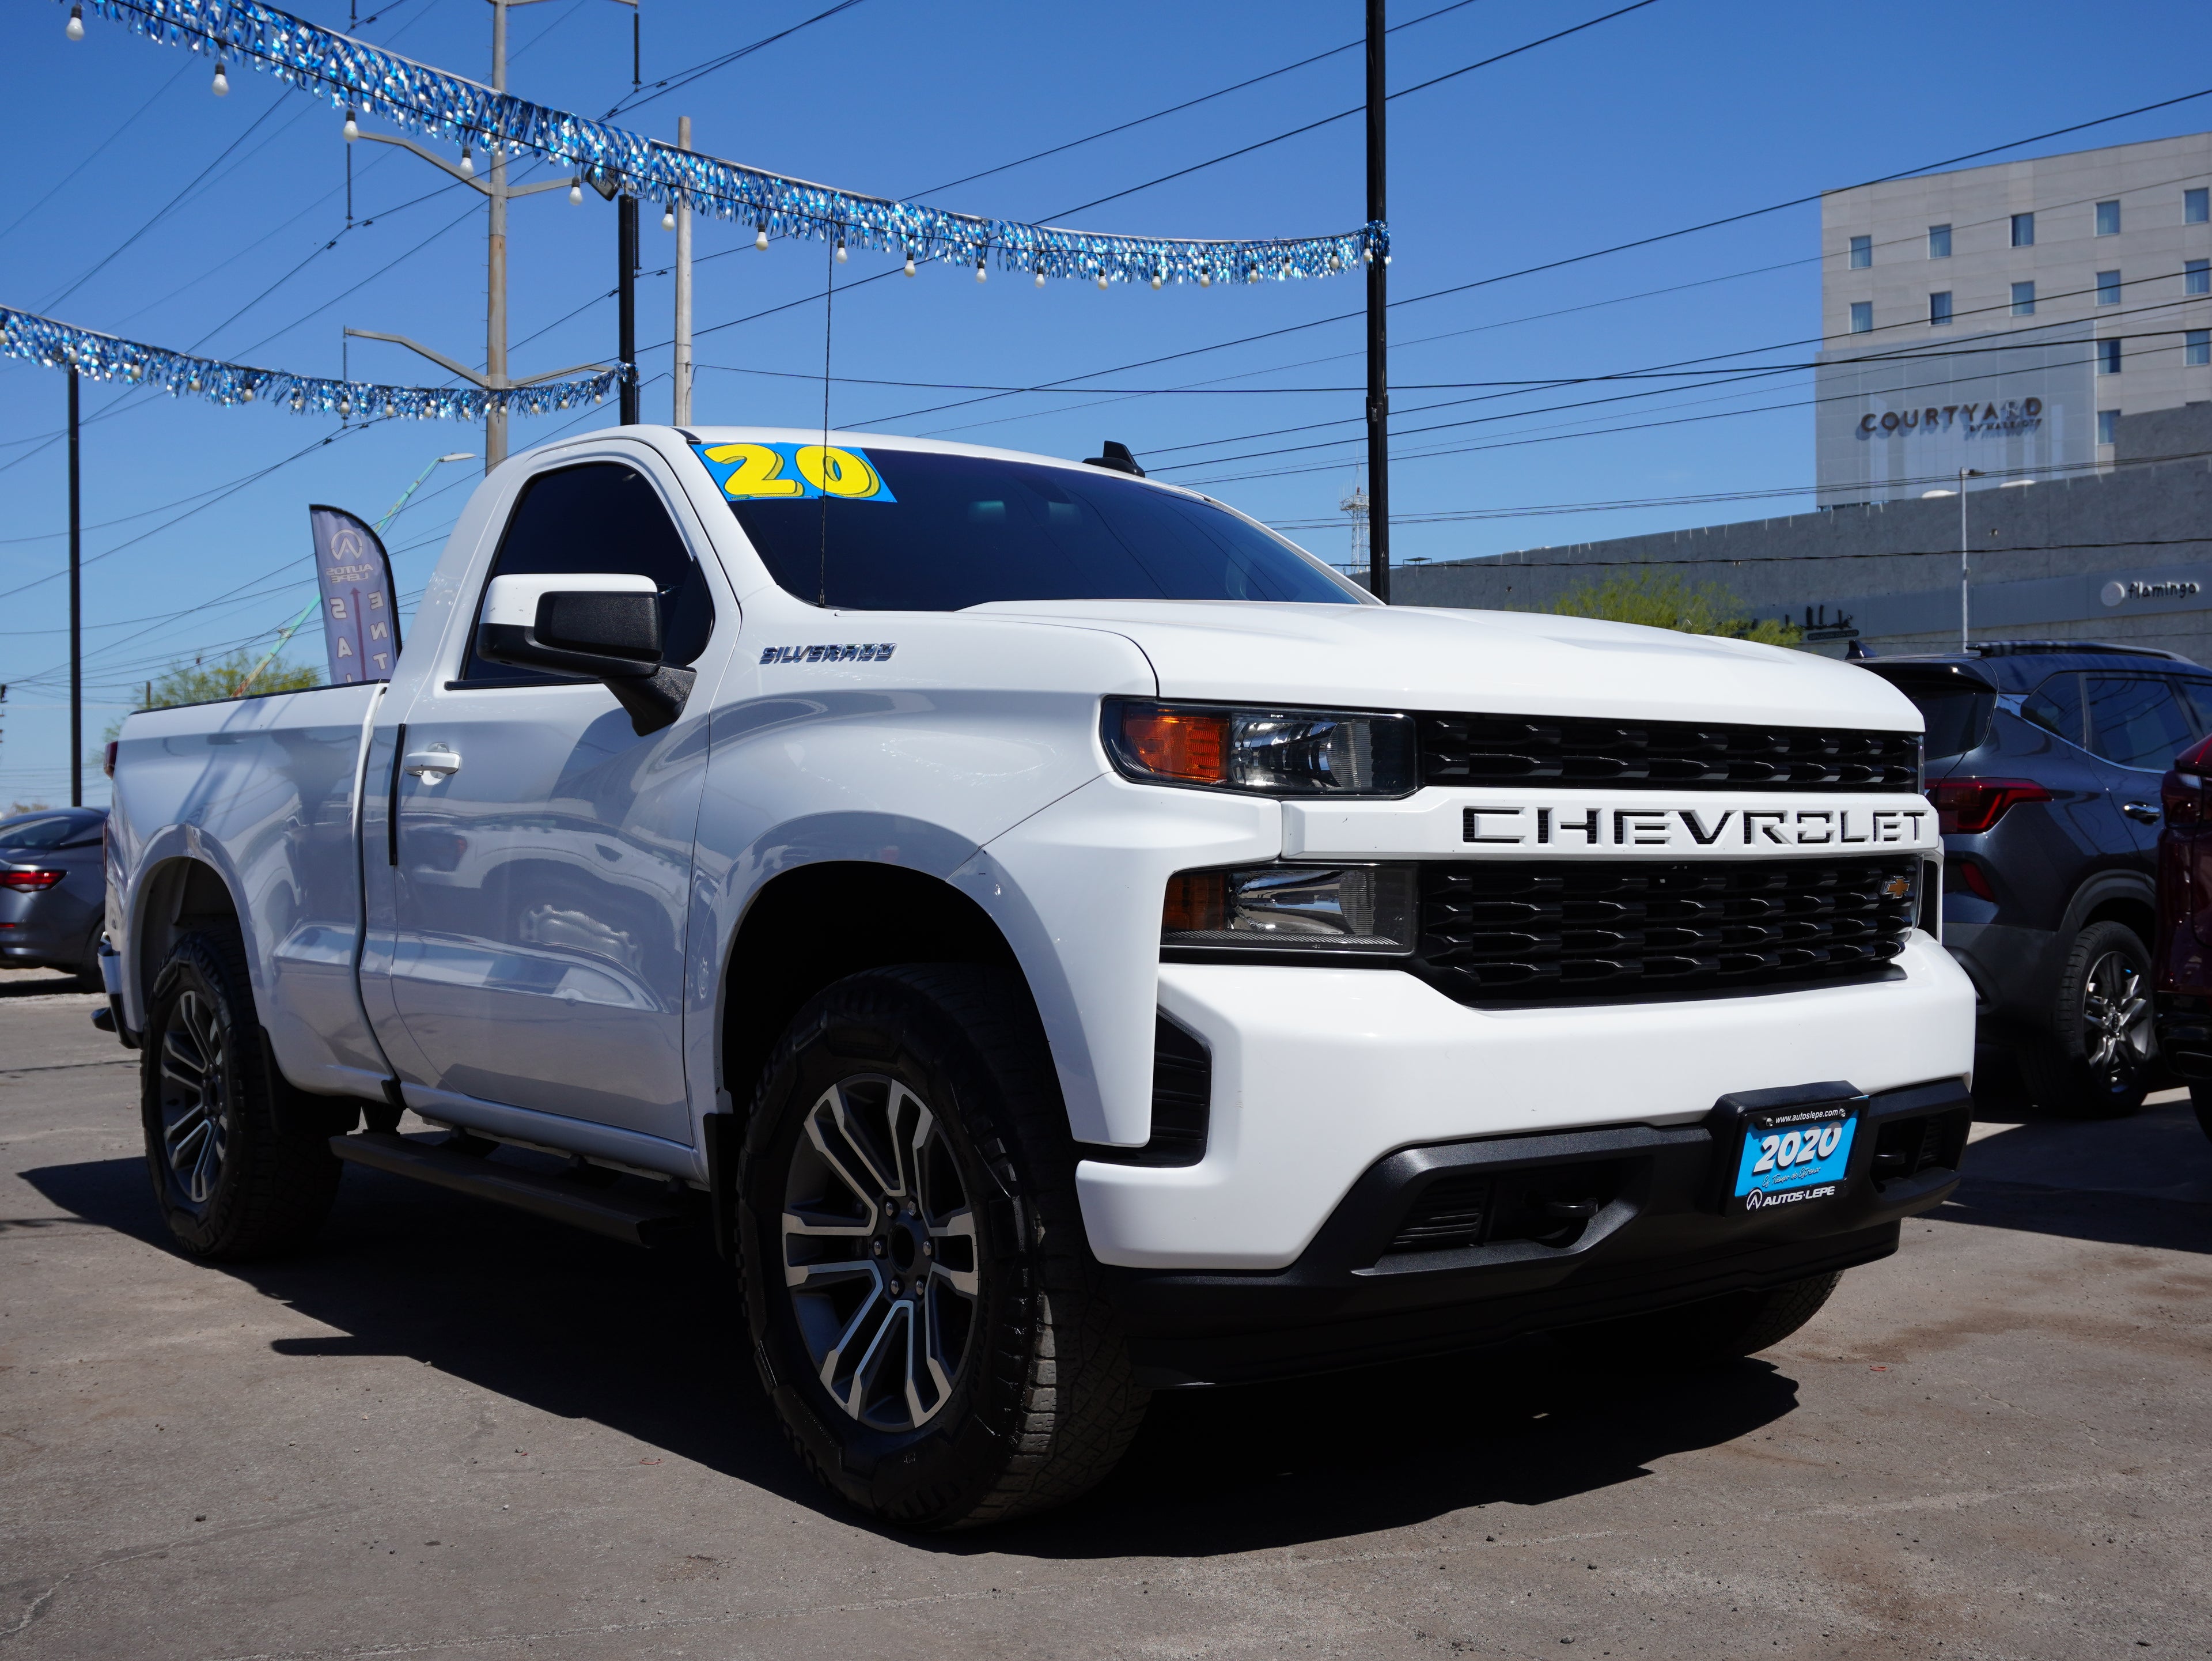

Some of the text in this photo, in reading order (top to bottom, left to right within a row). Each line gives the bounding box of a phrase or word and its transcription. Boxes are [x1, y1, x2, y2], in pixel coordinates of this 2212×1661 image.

[1861, 397, 2043, 432] COURTYARD
[704, 443, 880, 498] 20
[2128, 581, 2200, 599] flamingo
[759, 643, 897, 665] SILVERADO
[1463, 806, 1930, 845] CHEVROLET
[1775, 1108, 1838, 1123] www.autoslepe.com
[1753, 1122, 1842, 1173] 2020
[1790, 1171, 1798, 1181] de
